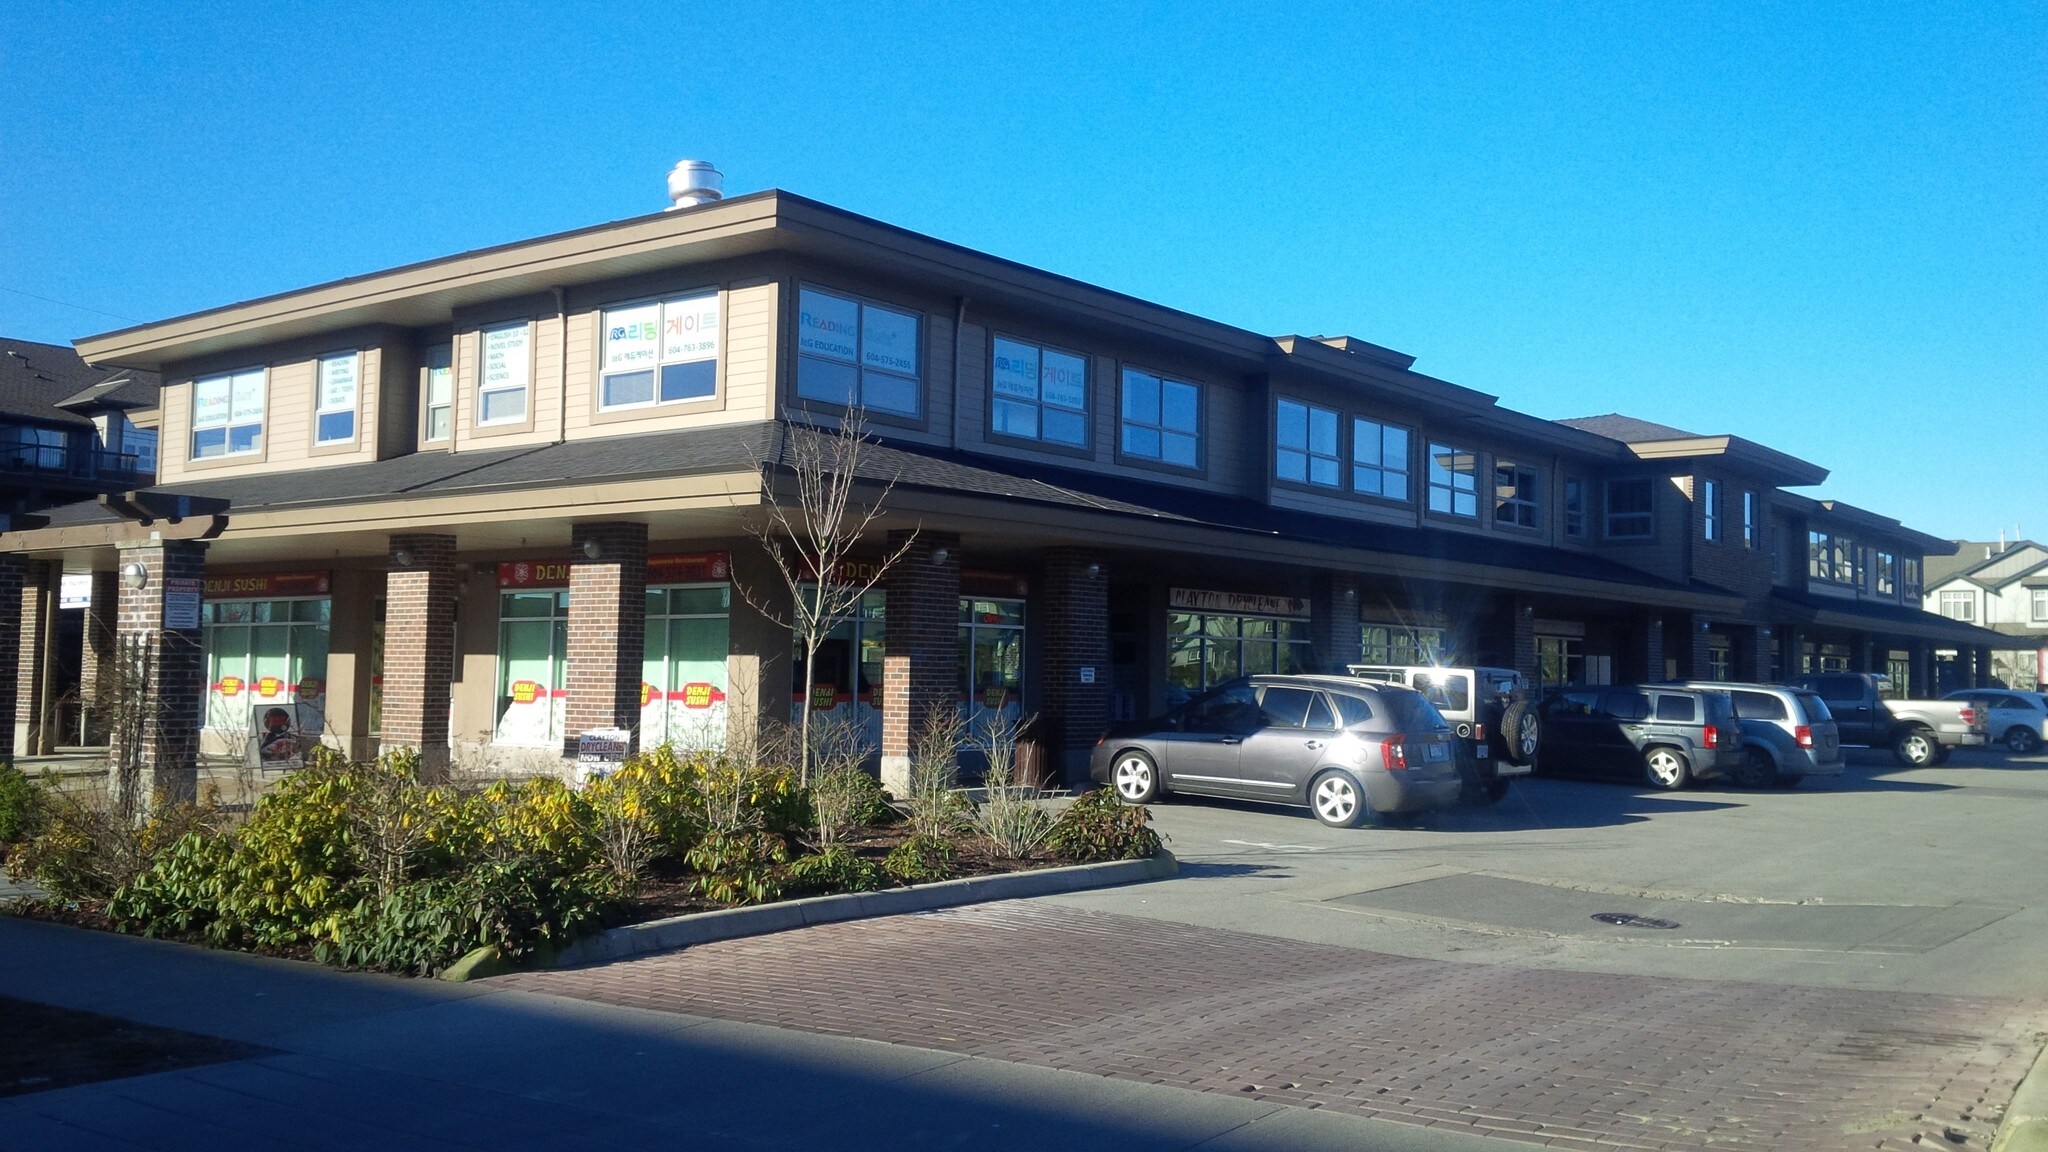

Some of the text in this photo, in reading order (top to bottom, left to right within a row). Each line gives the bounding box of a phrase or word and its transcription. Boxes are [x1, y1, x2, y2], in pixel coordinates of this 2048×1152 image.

[628, 319, 658, 341] 리딩
[666, 312, 718, 336] 게이트
[801, 311, 855, 337] READING
[668, 341, 715, 355] 604-763-3896
[815, 339, 854, 356] EDUCATION
[233, 577, 268, 592] SUSHI
[514, 683, 536, 693] DENJI
[686, 686, 711, 696] DENJI
[513, 693, 534, 701] SUSHI
[685, 696, 709, 705] SUSHI
[580, 753, 601, 762] NOW
